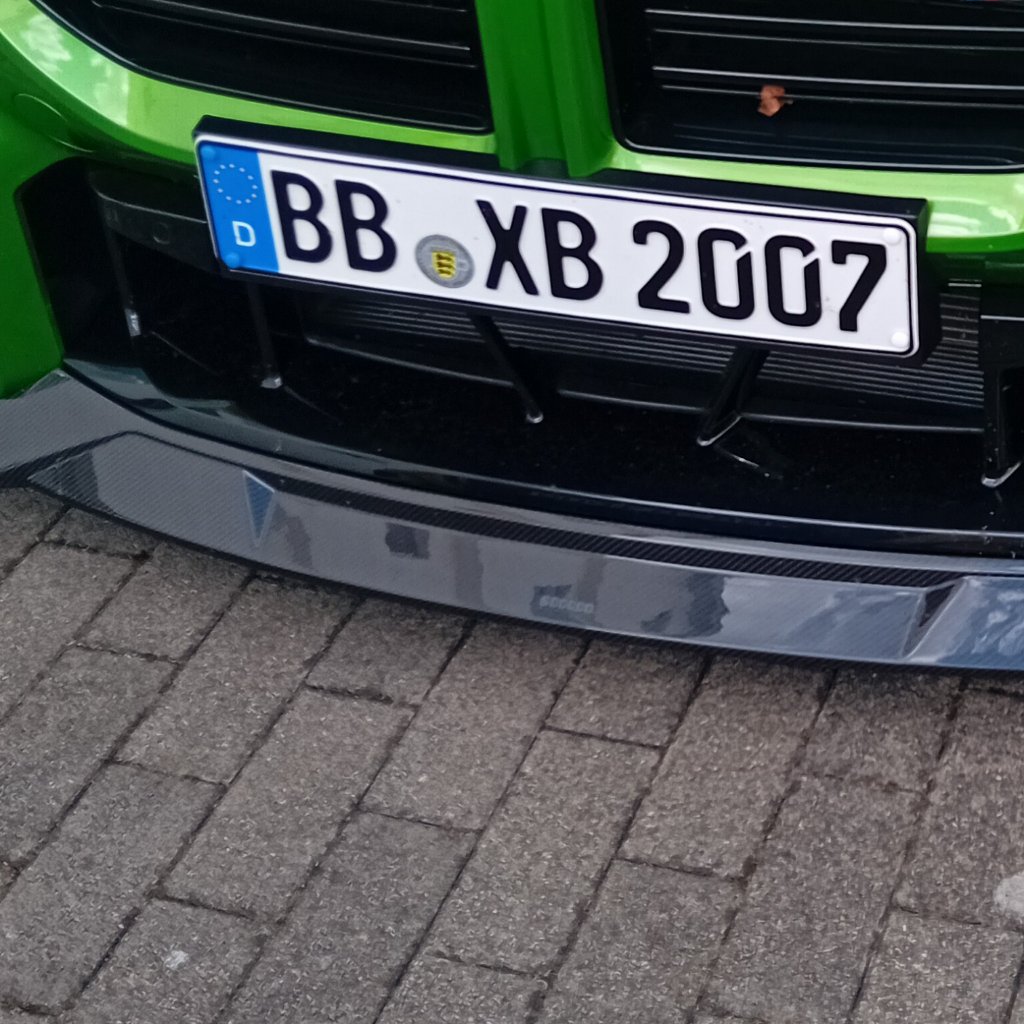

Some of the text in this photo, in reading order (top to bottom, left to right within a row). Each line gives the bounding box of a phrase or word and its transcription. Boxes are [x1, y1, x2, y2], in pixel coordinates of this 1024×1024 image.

[232, 220, 256, 247] D
[271, 170, 888, 332] BB XB 2007
